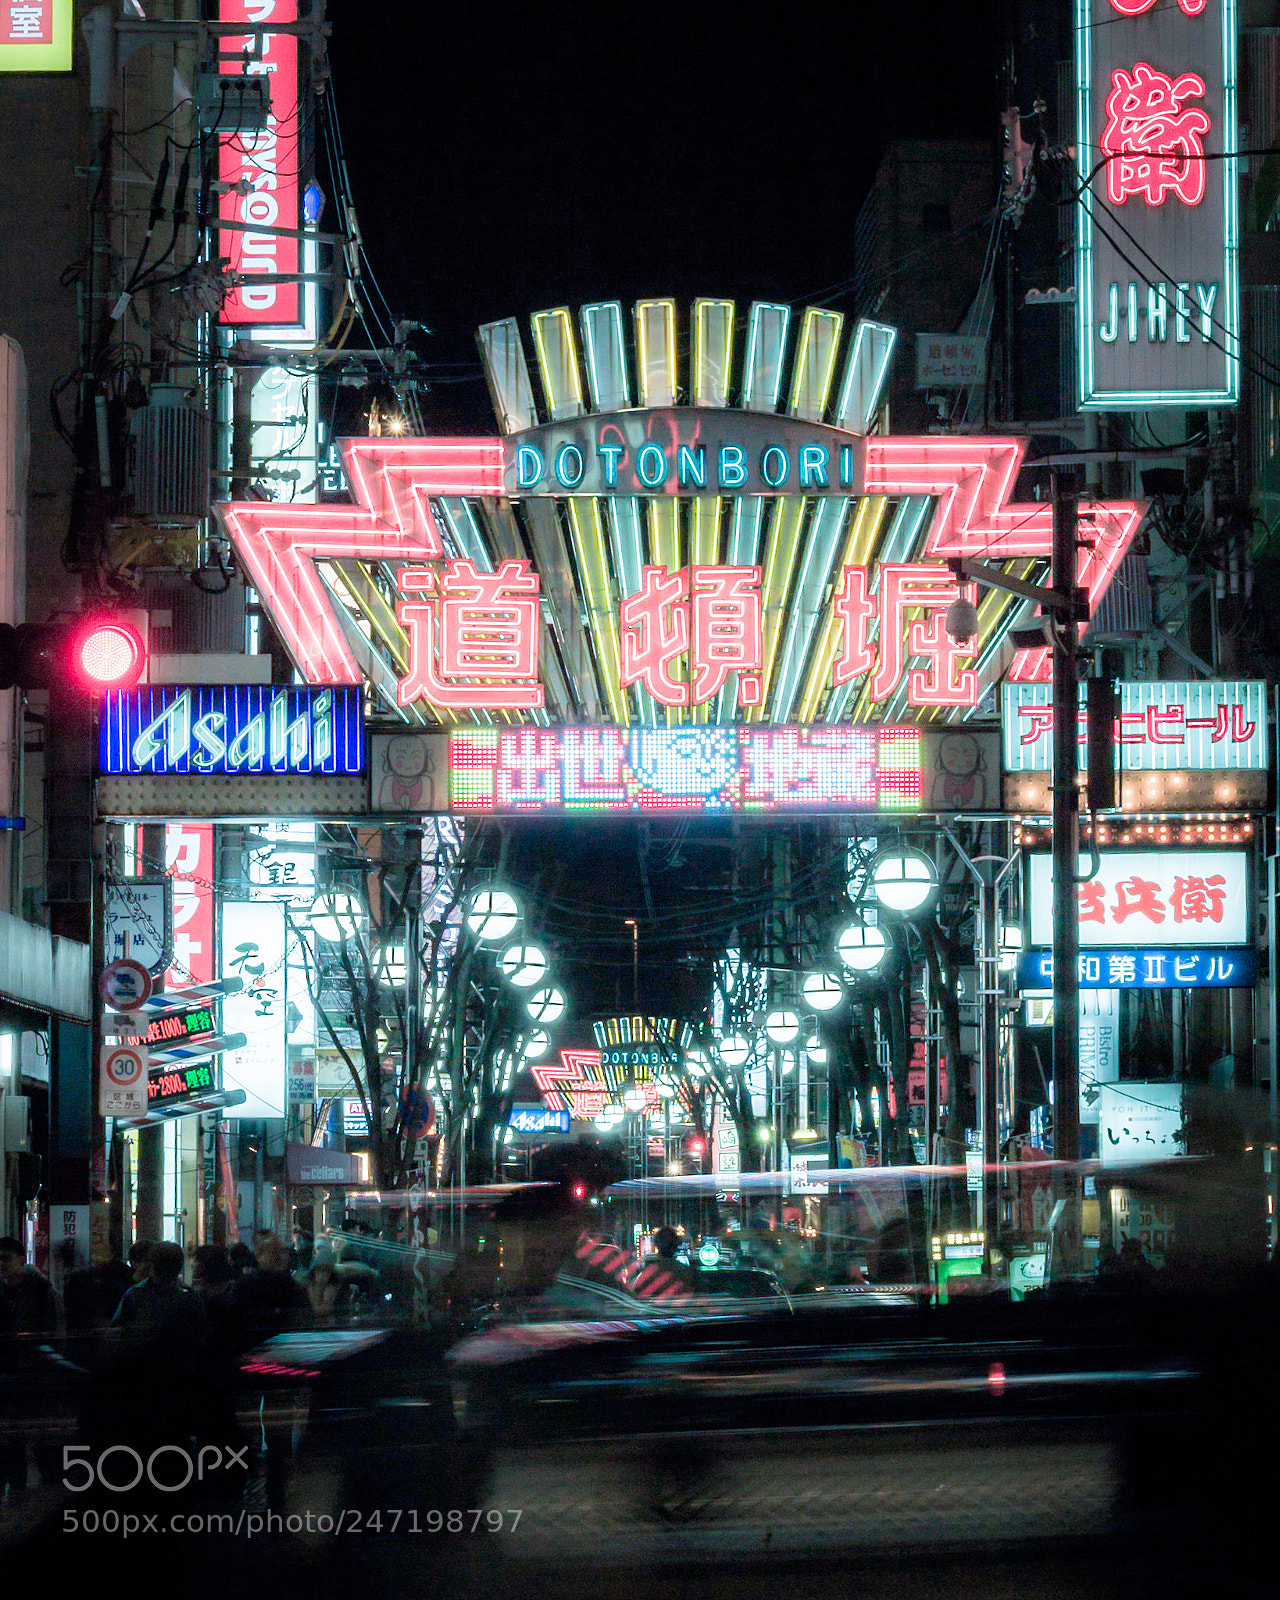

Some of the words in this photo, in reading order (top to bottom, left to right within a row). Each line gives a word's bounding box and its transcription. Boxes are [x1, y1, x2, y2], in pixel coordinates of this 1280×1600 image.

[9, 0, 44, 38] 室
[241, 113, 278, 310] OYSOUND
[1100, 282, 1218, 344] JIHEY
[516, 443, 854, 490] DOTONBORI
[397, 560, 979, 708] 道頓堀
[132, 689, 333, 768] Asahi
[1018, 704, 1256, 745] アヒビール
[497, 728, 626, 801] 出世
[1079, 1025, 1097, 1086] PRIMO
[1099, 1025, 1112, 1067] Bistro
[114, 1059, 135, 1076] 30
[106, 1101, 141, 1110] ここから
[511, 1111, 561, 1131] Asahi
[311, 1165, 345, 1180] cellars
[63, 1210, 77, 1247] 防犯
